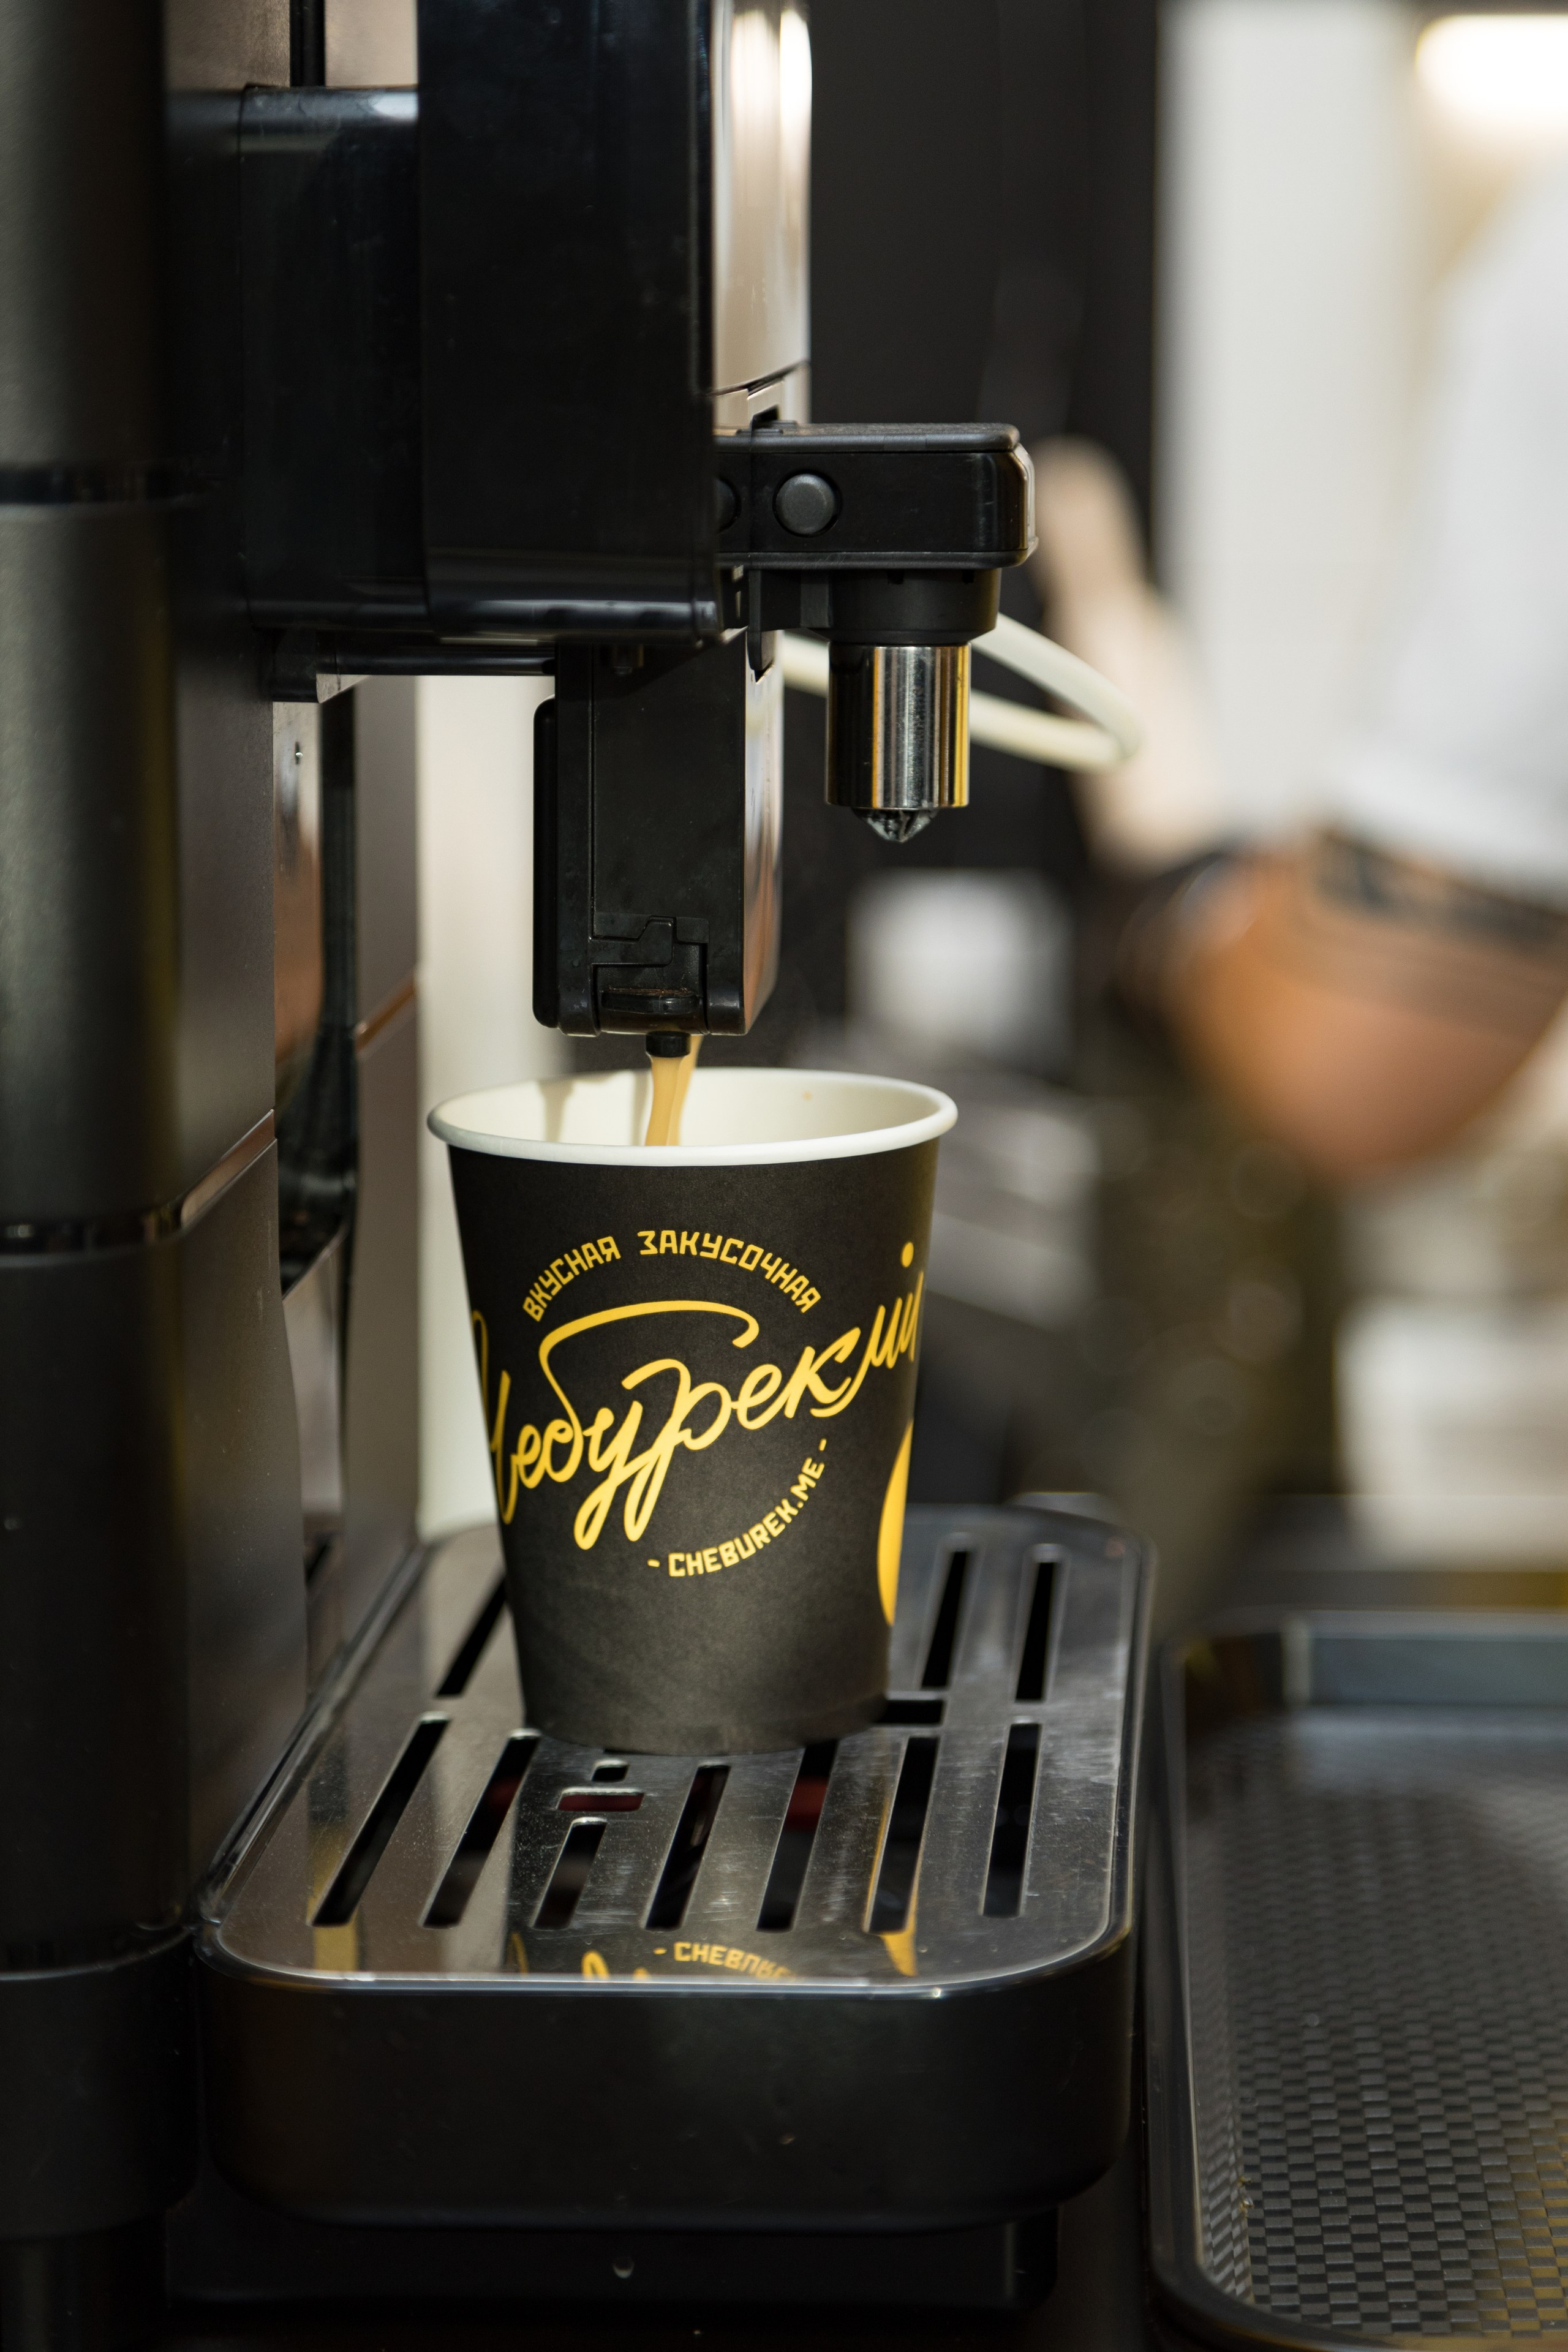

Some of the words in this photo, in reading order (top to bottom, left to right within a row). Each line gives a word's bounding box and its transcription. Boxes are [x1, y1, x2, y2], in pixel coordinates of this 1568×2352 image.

[522, 1235, 622, 1322] ВКУСНАЯ
[637, 1229, 821, 1314] ЗАКУСОЧНАЯ
[668, 1457, 826, 1578] CHEBUREK.ME
